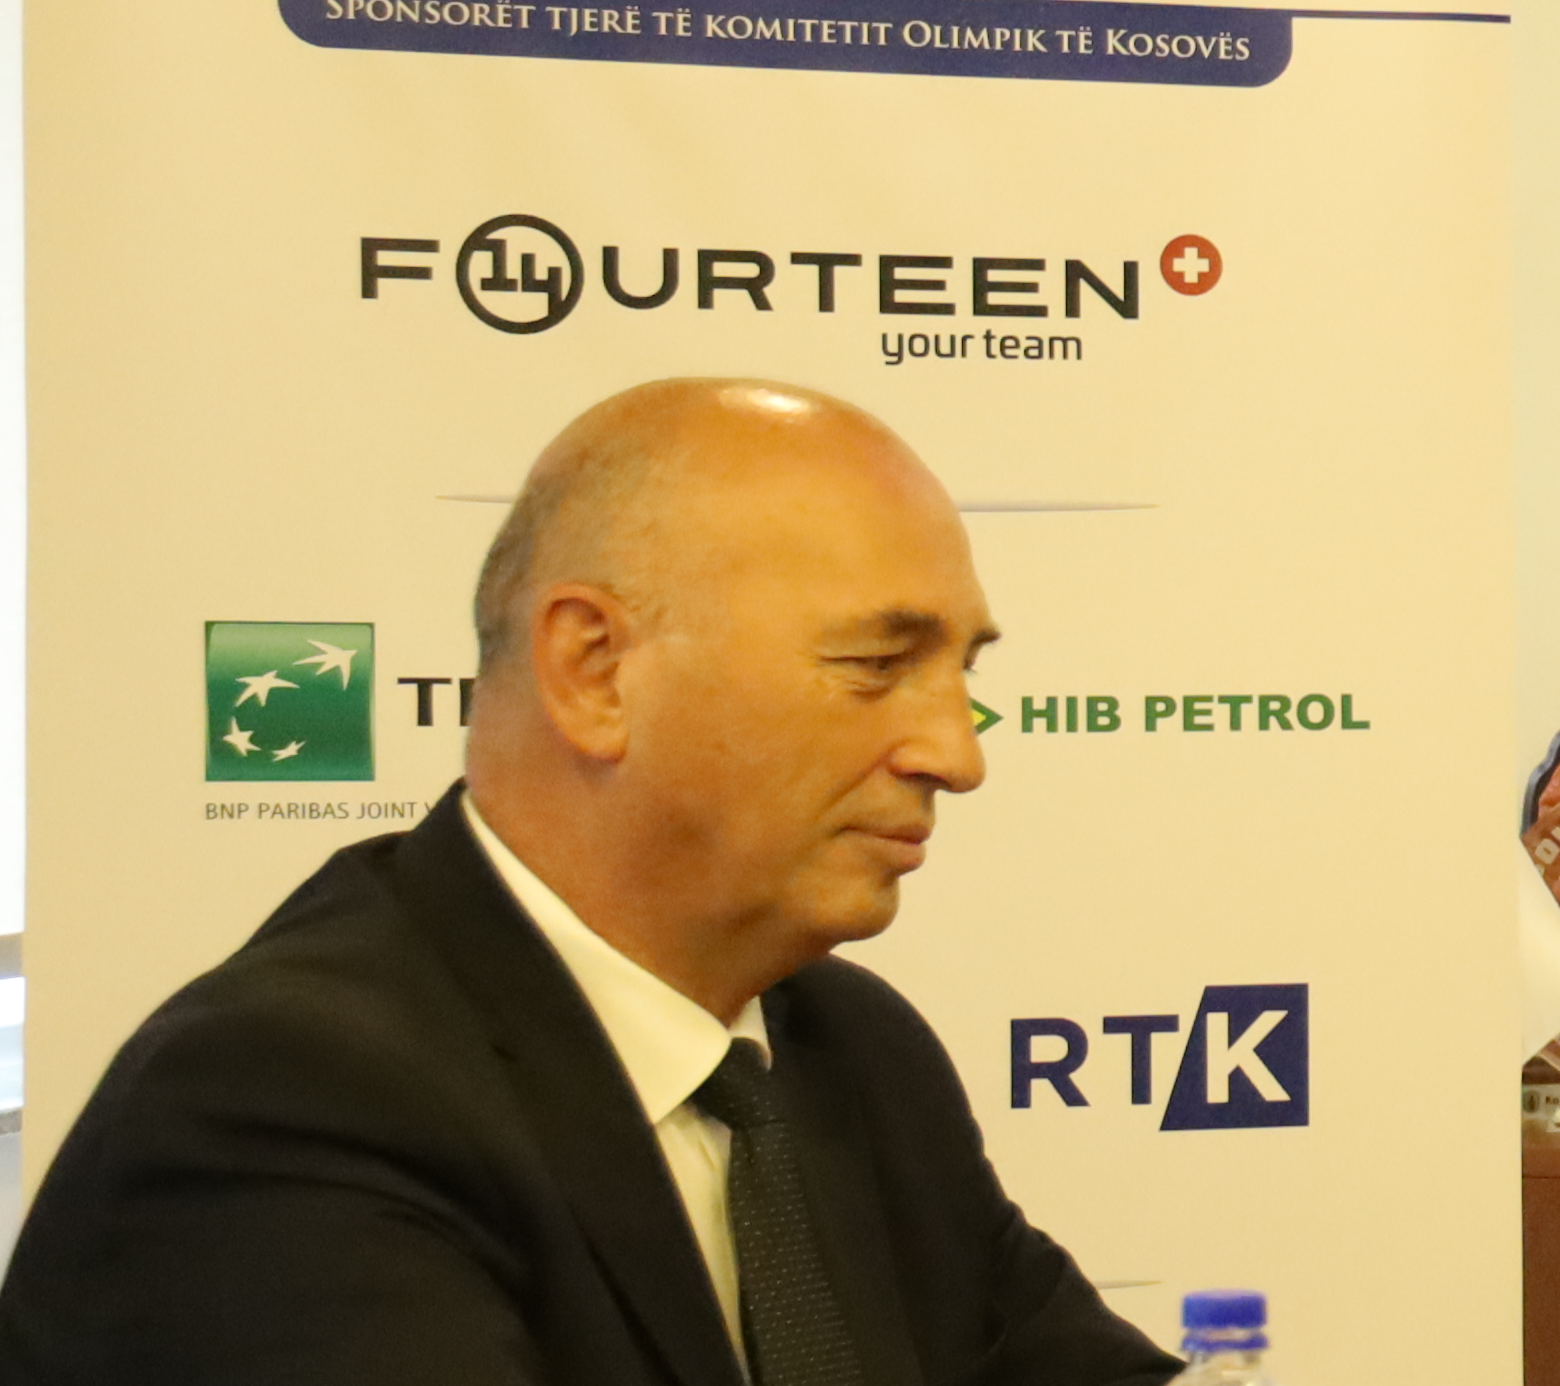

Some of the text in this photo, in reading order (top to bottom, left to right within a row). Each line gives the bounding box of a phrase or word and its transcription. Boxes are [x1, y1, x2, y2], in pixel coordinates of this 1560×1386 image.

[545, 5, 642, 38] TJERË
[652, 8, 693, 38] TË
[705, 13, 893, 47] KOMITETIT
[1056, 25, 1094, 55] TË
[881, 329, 1082, 365] your team
[1021, 694, 1370, 733] HIB PETROL
[205, 802, 249, 820] BNP
[257, 802, 348, 820] PARIBAS
[357, 802, 417, 820] JOINT
[1010, 1009, 1292, 1109] RTK
